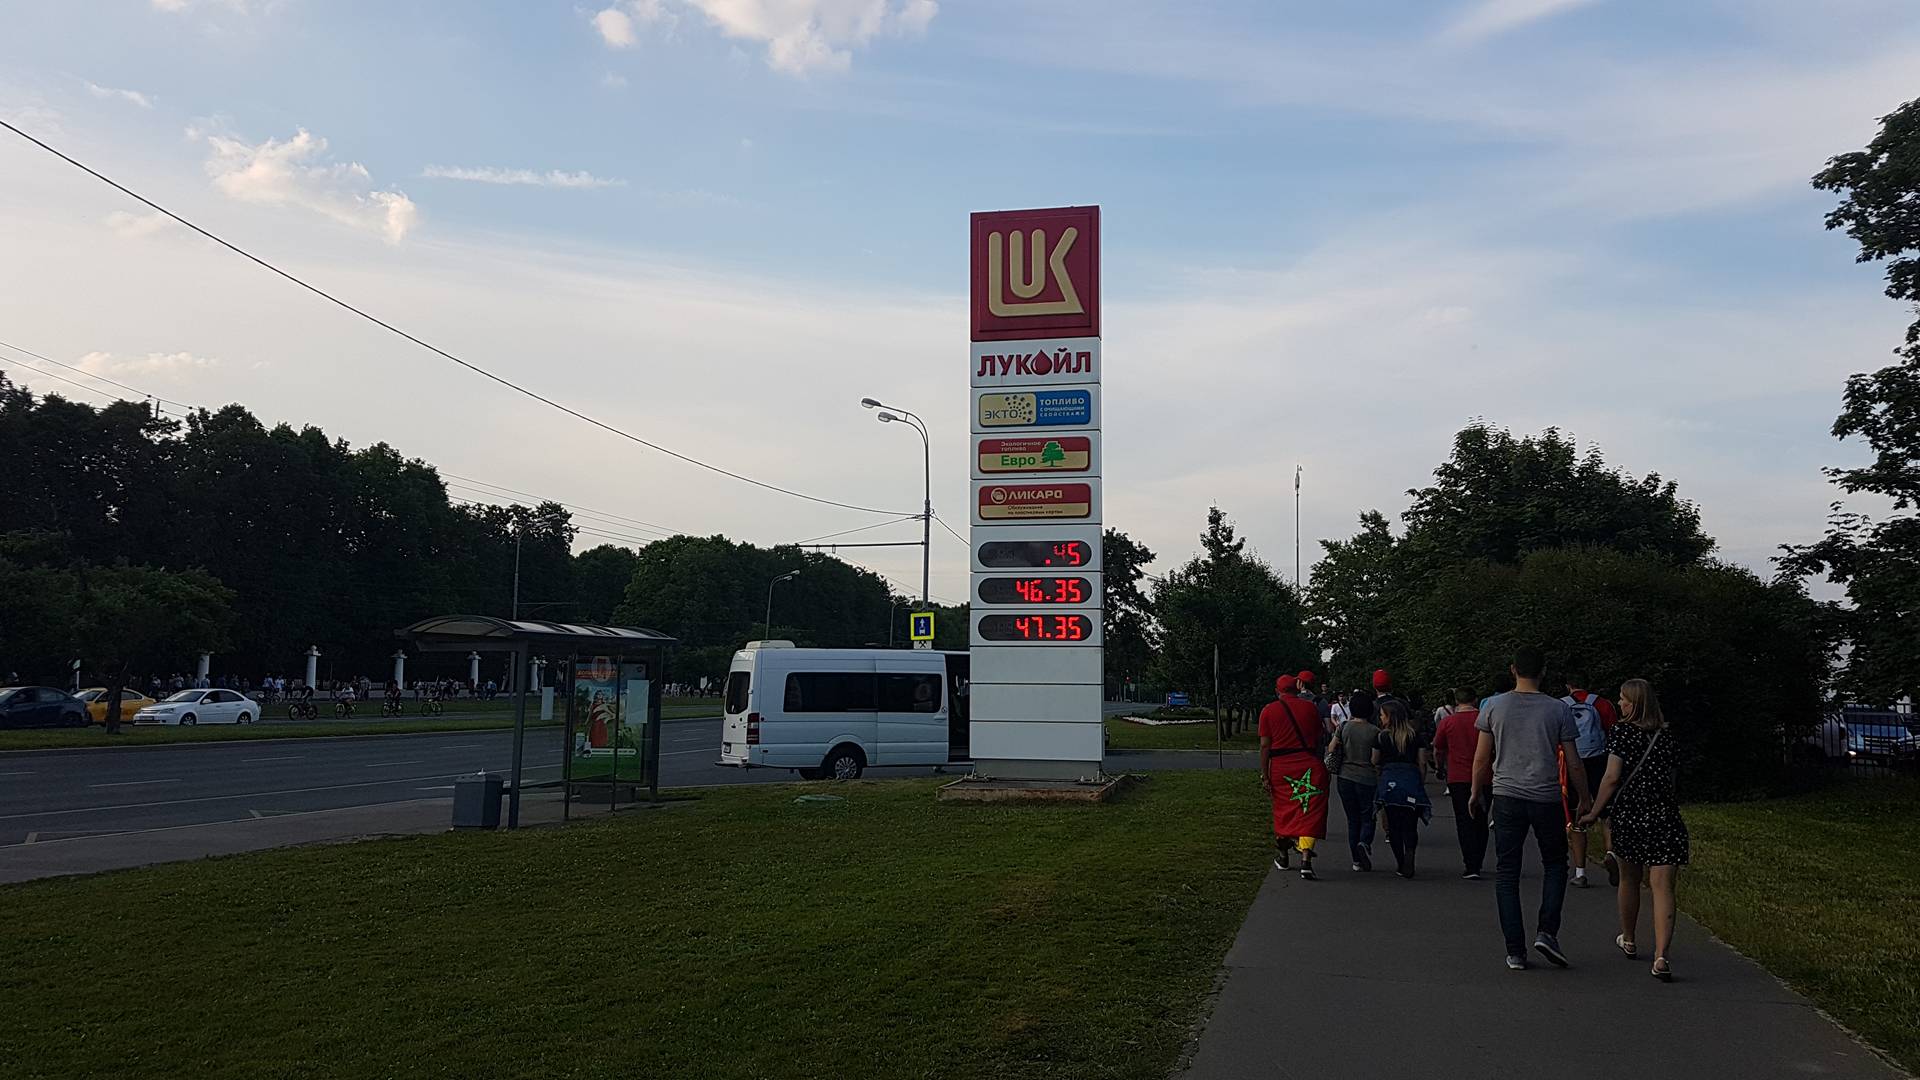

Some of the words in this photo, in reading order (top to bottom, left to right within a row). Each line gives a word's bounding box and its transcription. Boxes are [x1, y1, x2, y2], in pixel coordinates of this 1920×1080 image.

[1040, 397, 1085, 406] ТОПЛИВО
[984, 409, 1018, 420] ЭКТО
[1001, 455, 1036, 468] Евро
[1015, 580, 1081, 602] 46.35
[1015, 616, 1081, 639] 47.35
